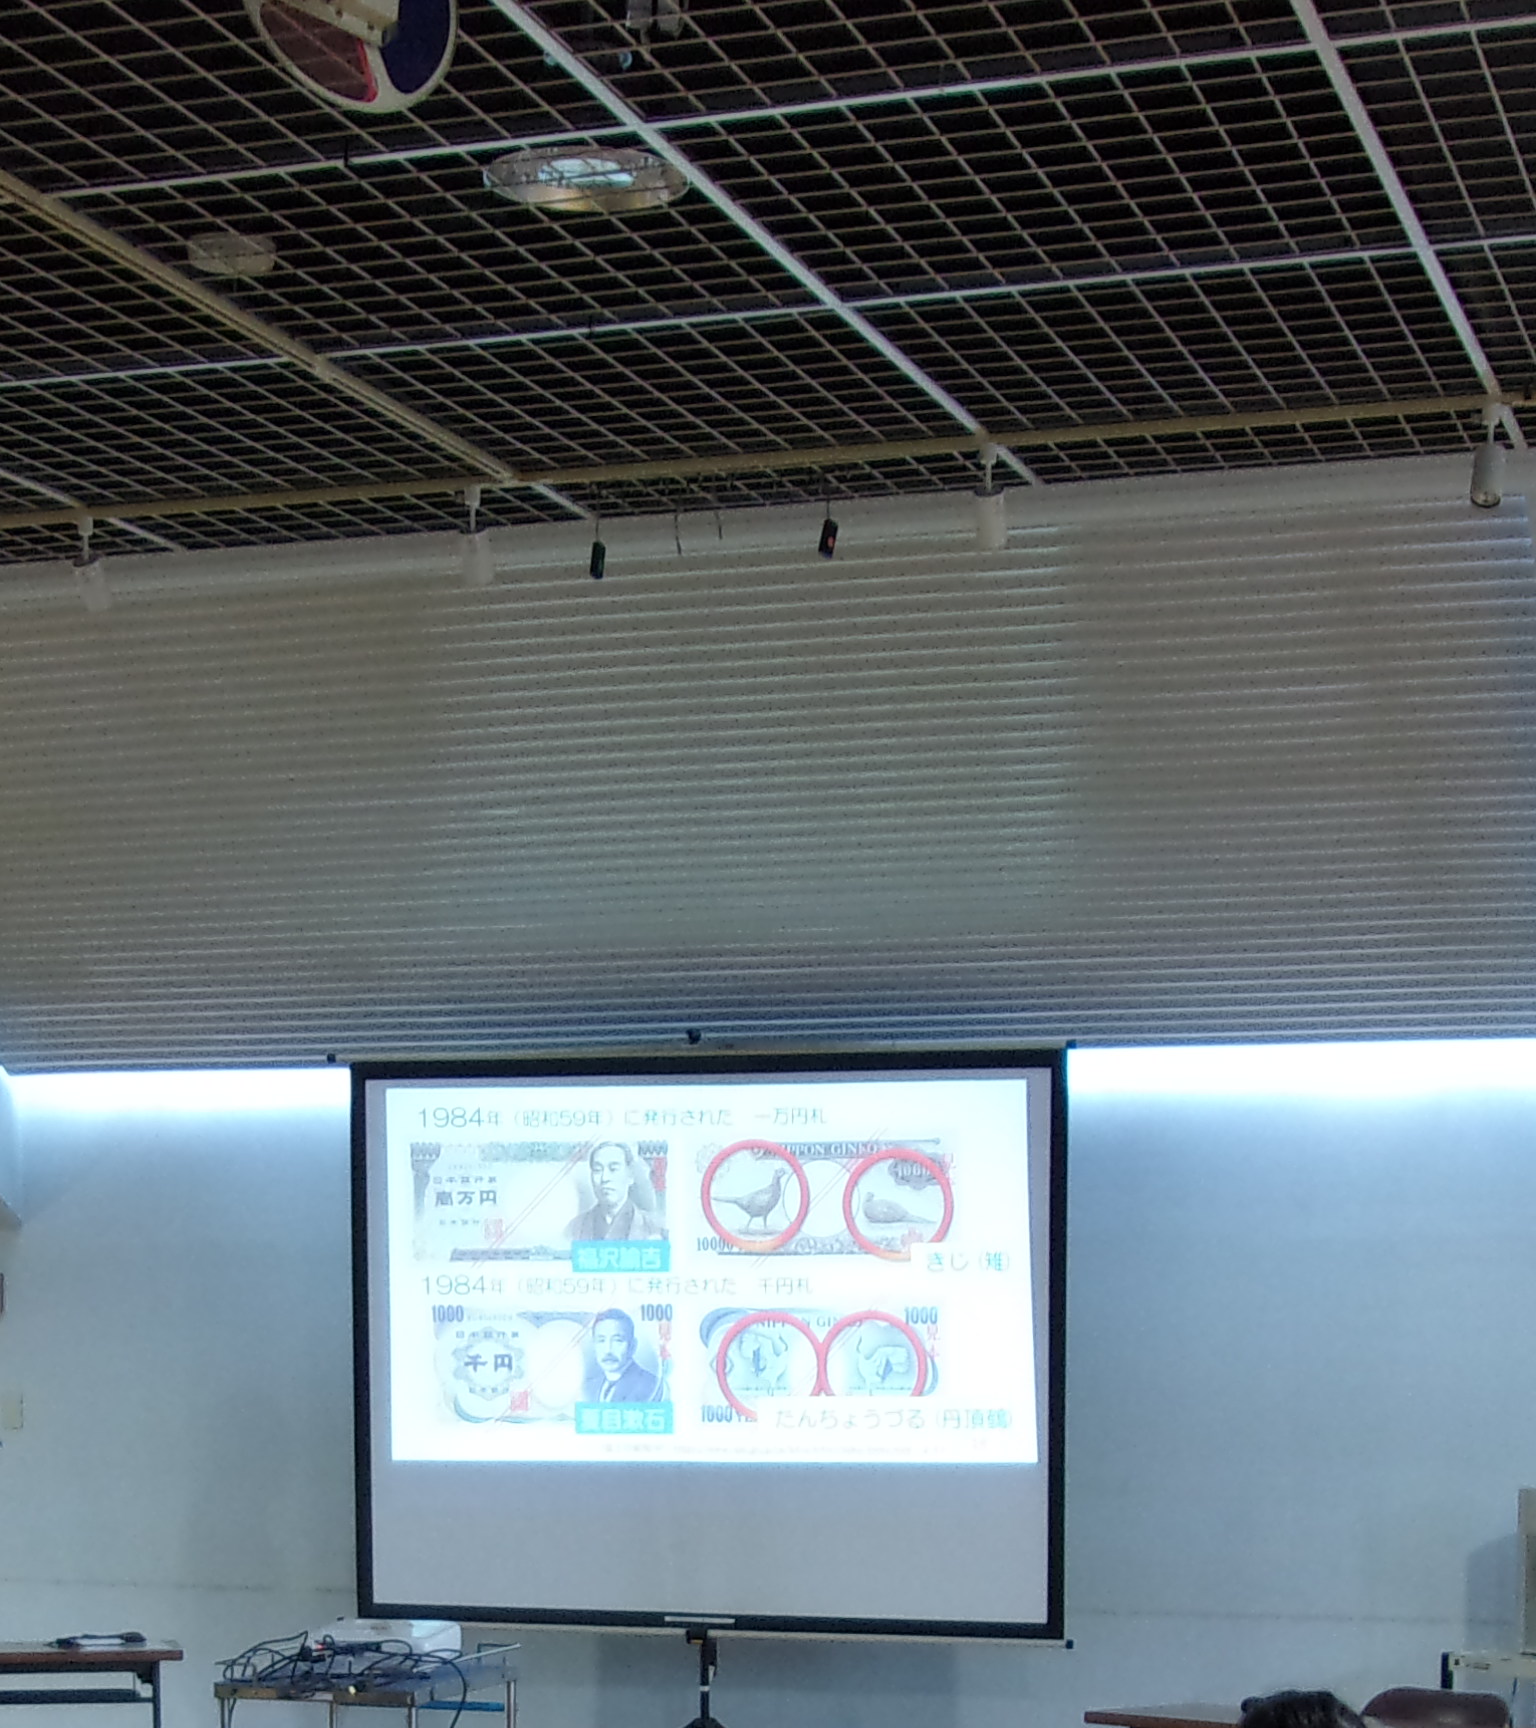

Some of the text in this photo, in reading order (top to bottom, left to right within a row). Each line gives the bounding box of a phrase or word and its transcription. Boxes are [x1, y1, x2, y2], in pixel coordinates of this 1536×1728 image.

[431, 1304, 465, 1323] 1000
[640, 1303, 673, 1322] 1000
[904, 1306, 938, 1325] 1000
[463, 1353, 513, 1373] 千円
